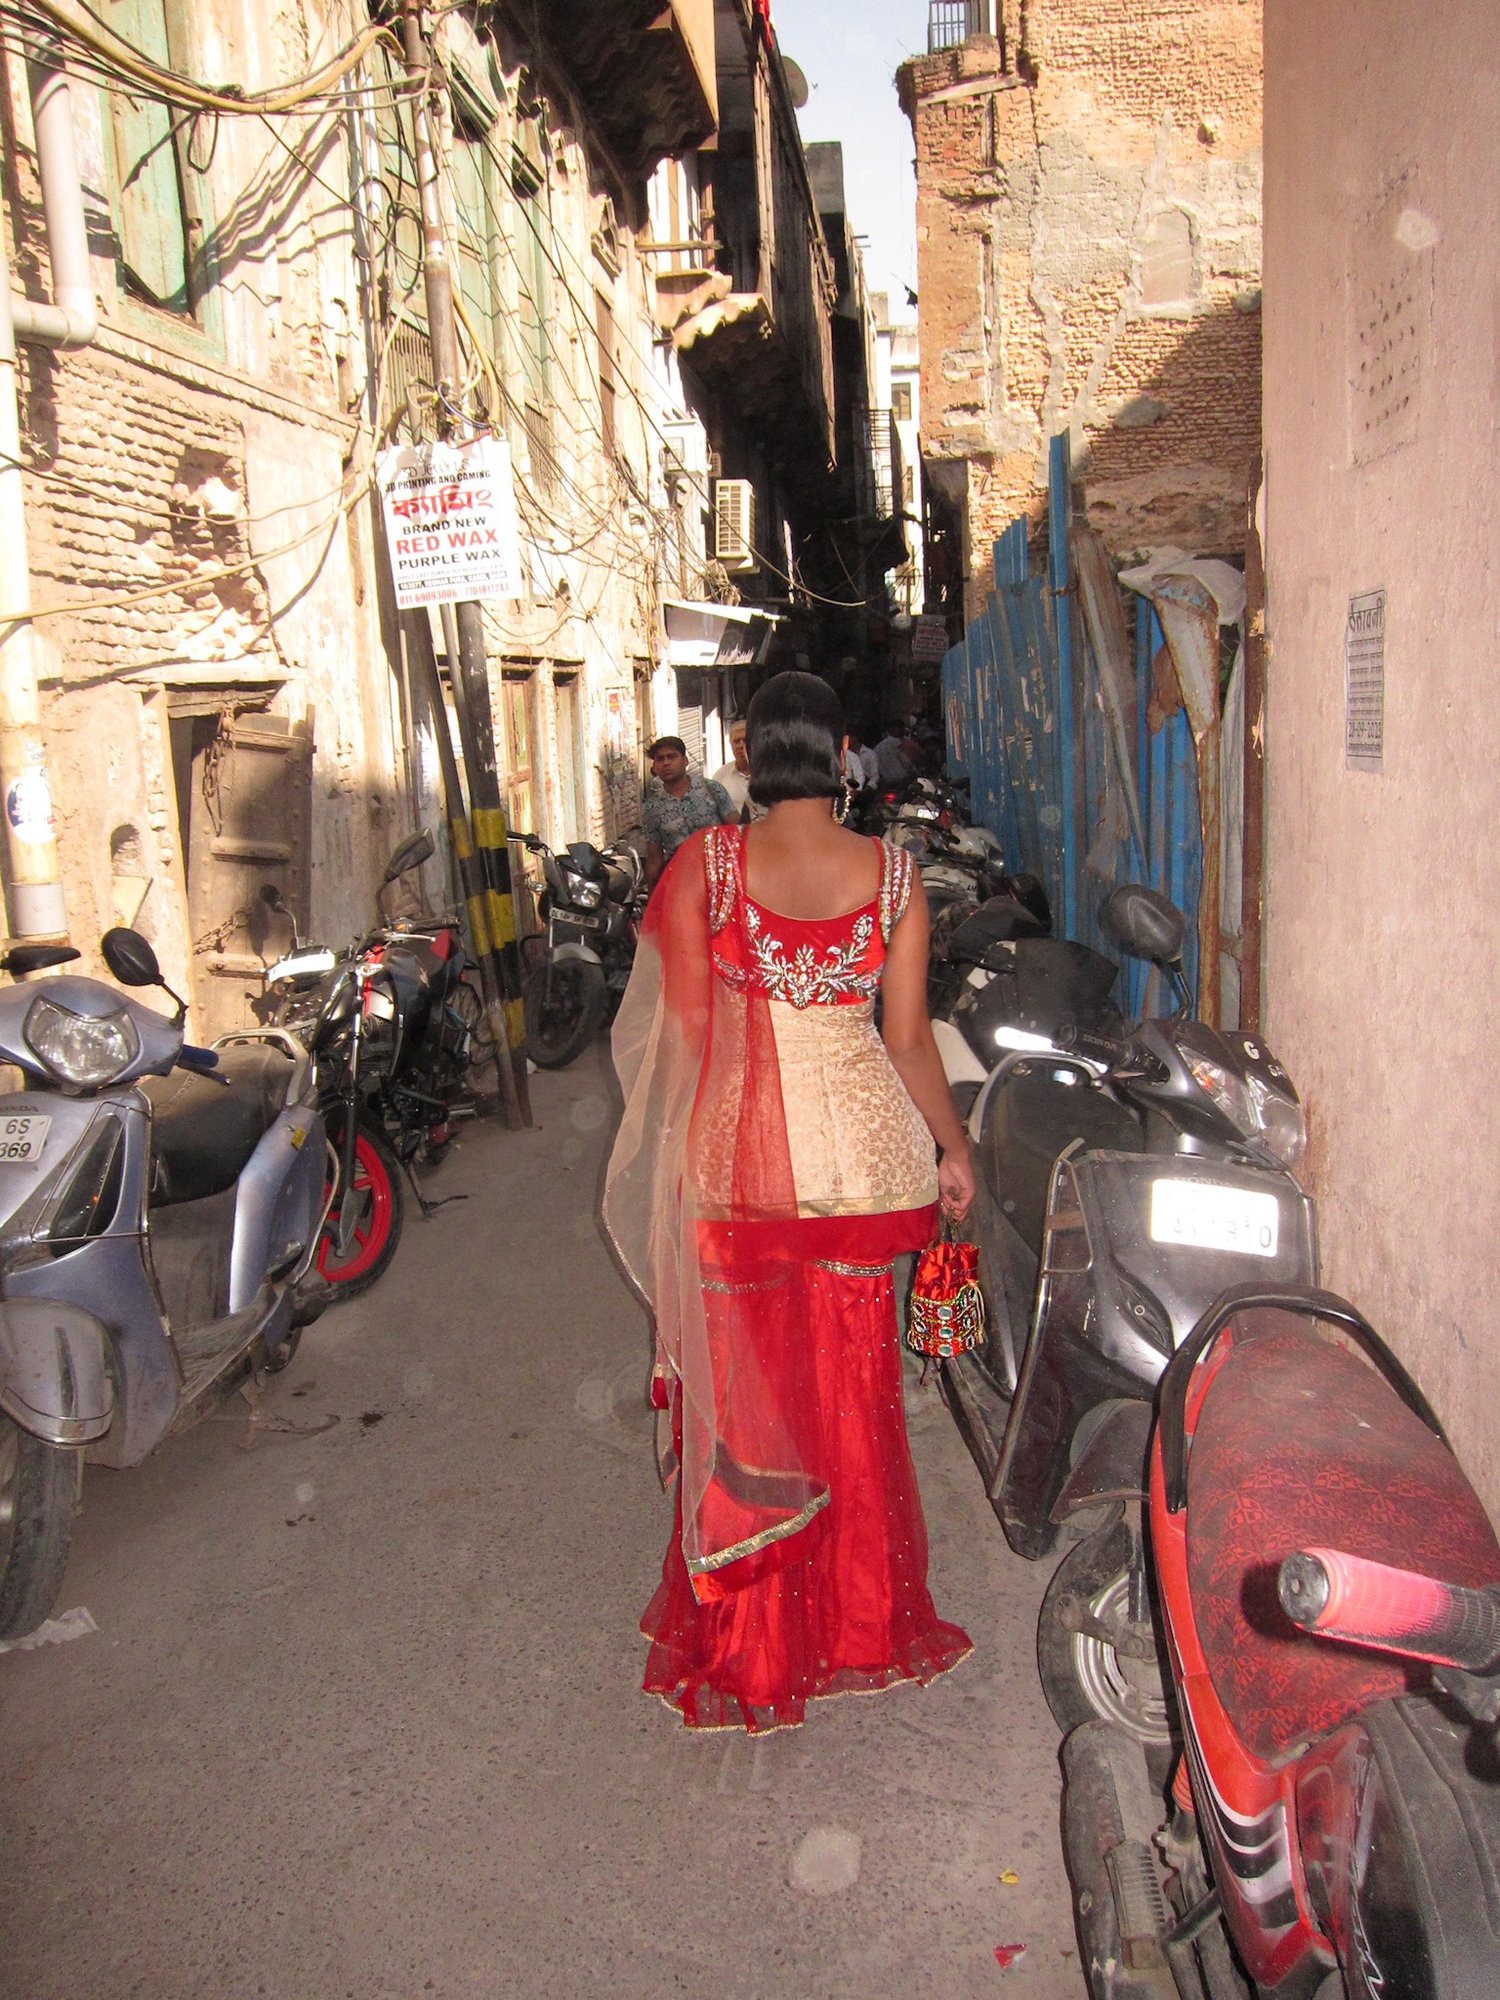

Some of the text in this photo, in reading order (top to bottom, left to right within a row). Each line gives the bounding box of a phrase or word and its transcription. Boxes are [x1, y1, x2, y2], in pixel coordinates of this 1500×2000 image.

[385, 481, 396, 493] 3D
[398, 476, 437, 489] PRINTING
[438, 473, 456, 484] AND
[403, 516, 487, 536] BRAND NEW
[396, 528, 499, 555] RED WAX
[398, 548, 502, 570] PURPLE WAX
[6, 1118, 31, 1134] 6S
